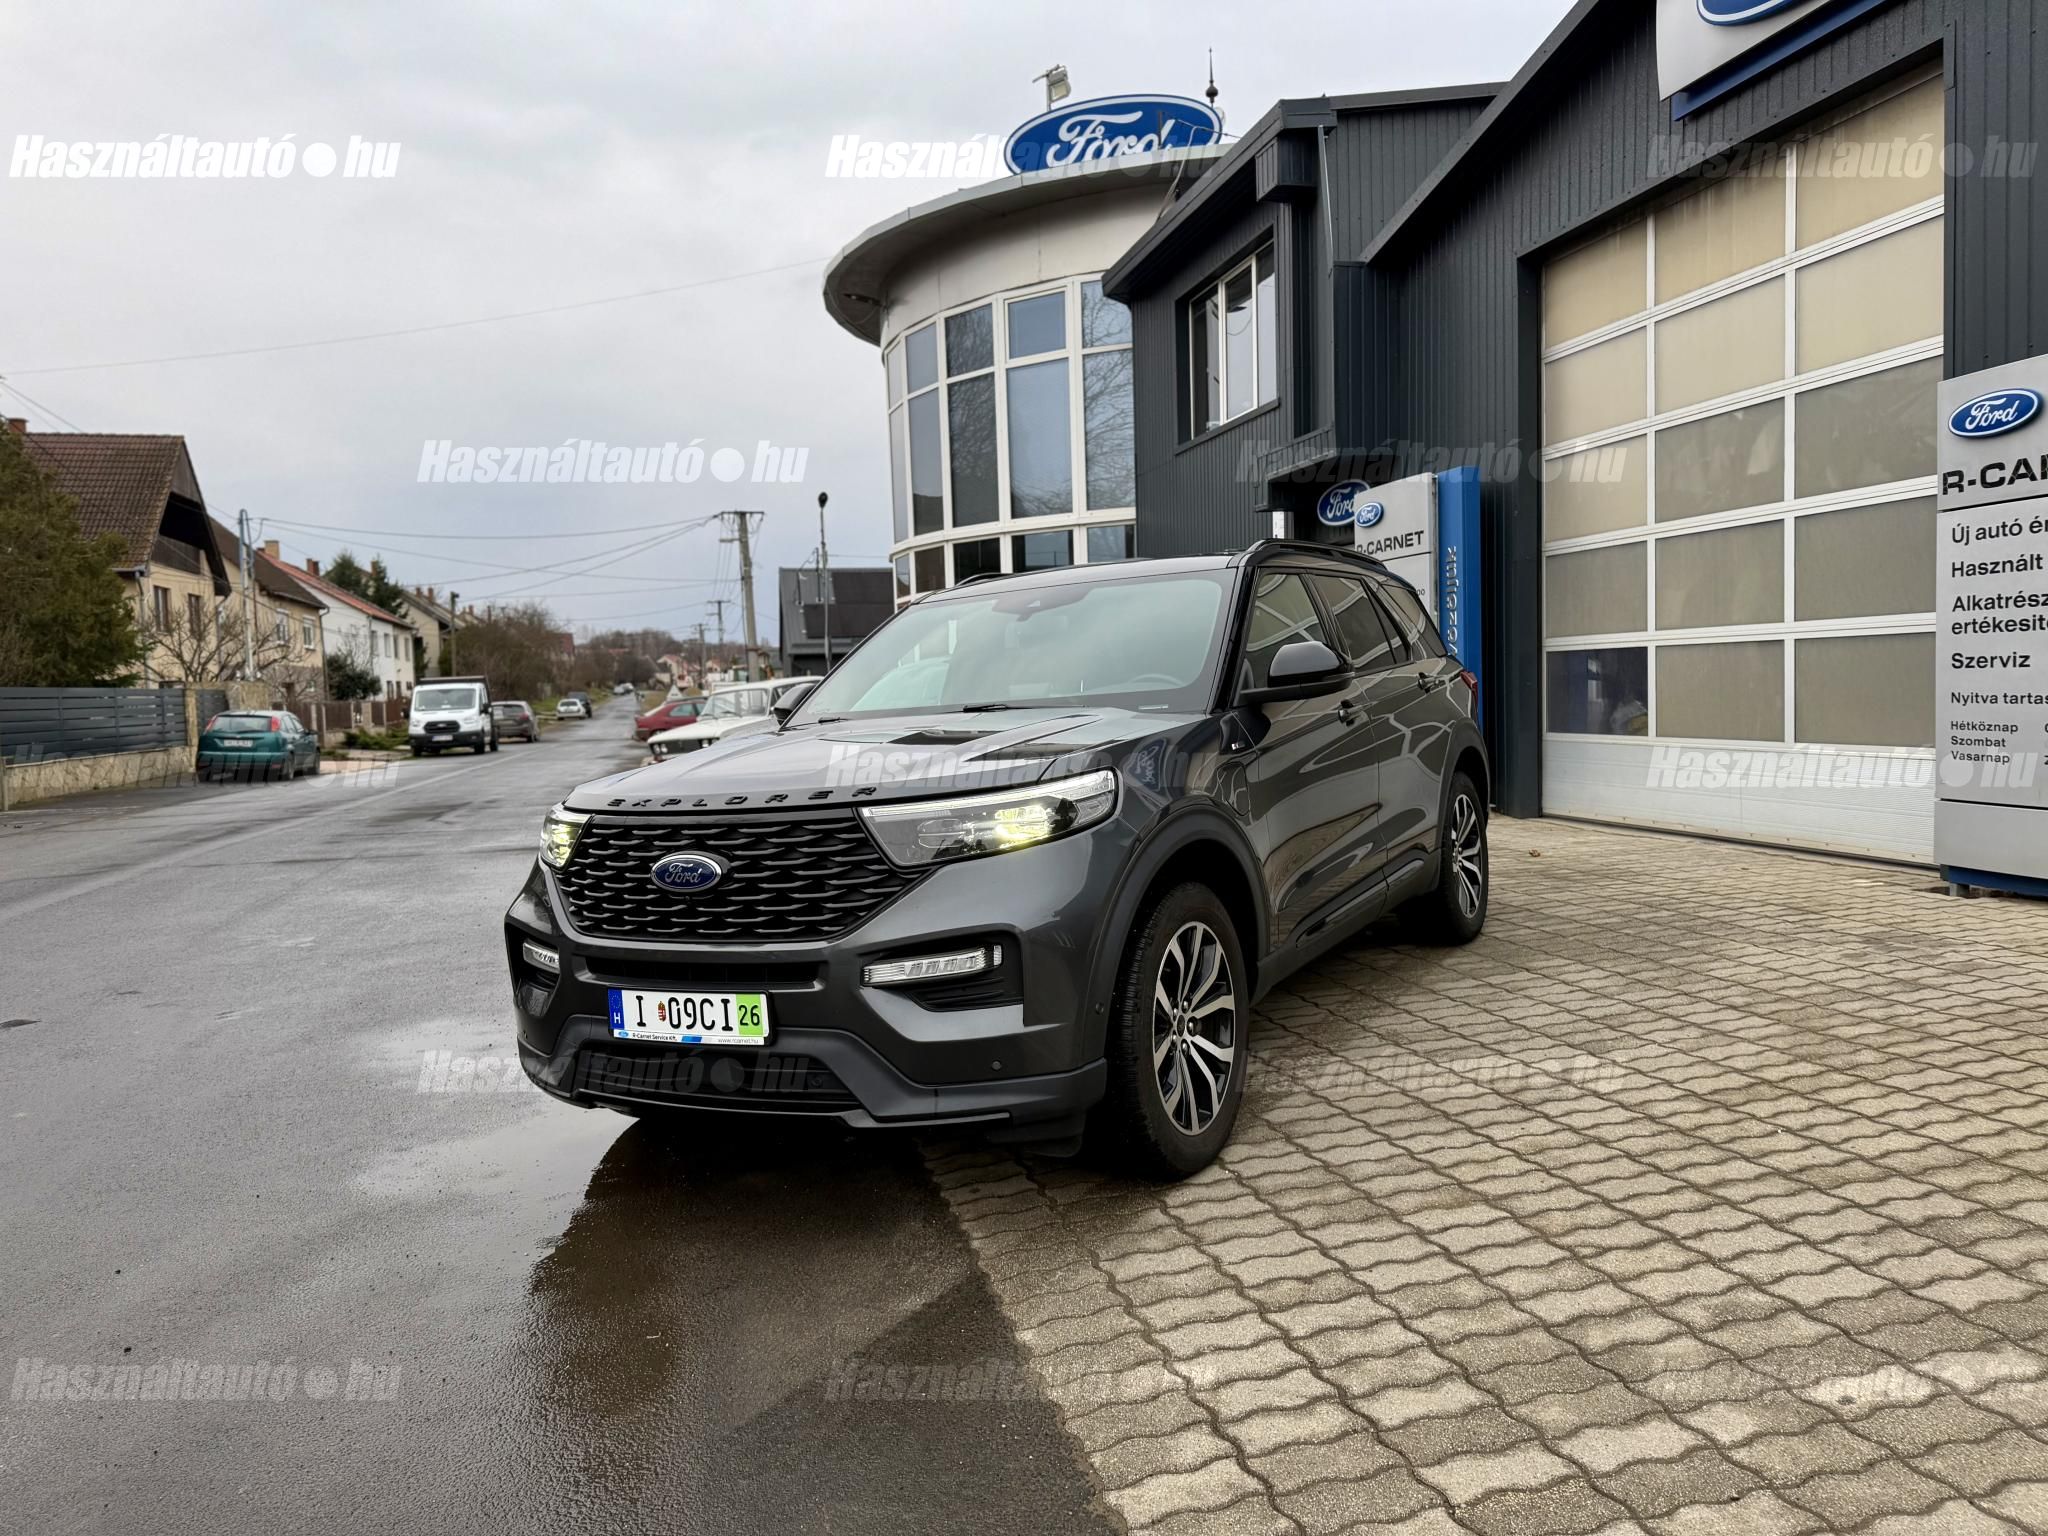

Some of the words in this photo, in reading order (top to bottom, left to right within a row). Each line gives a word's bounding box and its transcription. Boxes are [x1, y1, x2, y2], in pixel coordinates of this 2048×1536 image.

[1046, 110, 1175, 168] Ford
[1965, 397, 2020, 430] Ford
[1360, 506, 1377, 523] Ford
[1951, 523, 1970, 546] Új
[1975, 518, 2023, 540] autó
[1951, 553, 2044, 578] Használt
[1951, 614, 2048, 635] ertékesit
[1951, 651, 2031, 669] Szerviz
[1950, 691, 1999, 707] Nyitva
[1950, 720, 2019, 735] Hétköznap
[1950, 736, 2006, 748] Szombat
[1950, 750, 2011, 766] Vasarnap
[607, 786, 878, 808] EXPLORER
[664, 862, 702, 885] Ford
[613, 1012, 621, 1024] H
[738, 1004, 761, 1027] 26
